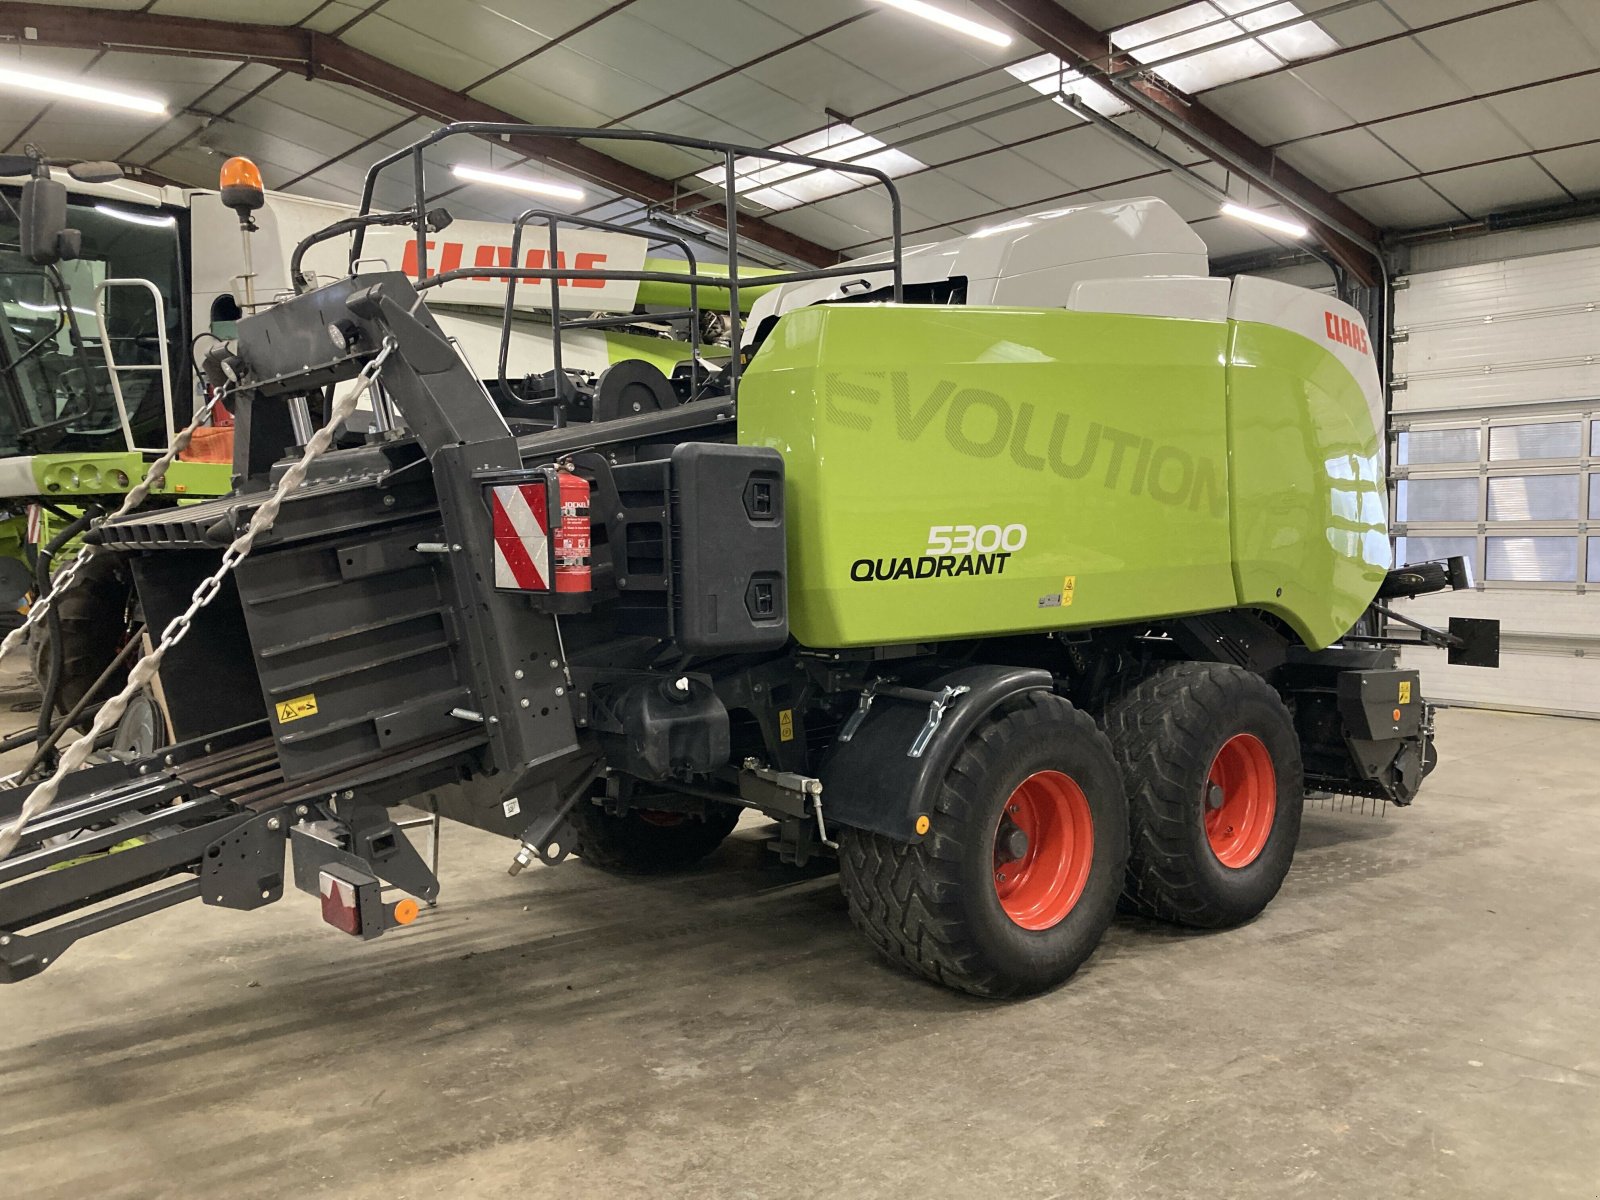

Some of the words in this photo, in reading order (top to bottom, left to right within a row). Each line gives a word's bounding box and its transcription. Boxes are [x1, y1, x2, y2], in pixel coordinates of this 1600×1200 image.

[401, 240, 607, 288] CLAAS
[1325, 311, 1368, 355] CLAAS
[826, 371, 1226, 519] EVOLUTION
[926, 523, 1027, 555] 5300
[850, 553, 1011, 581] QUADRANT
